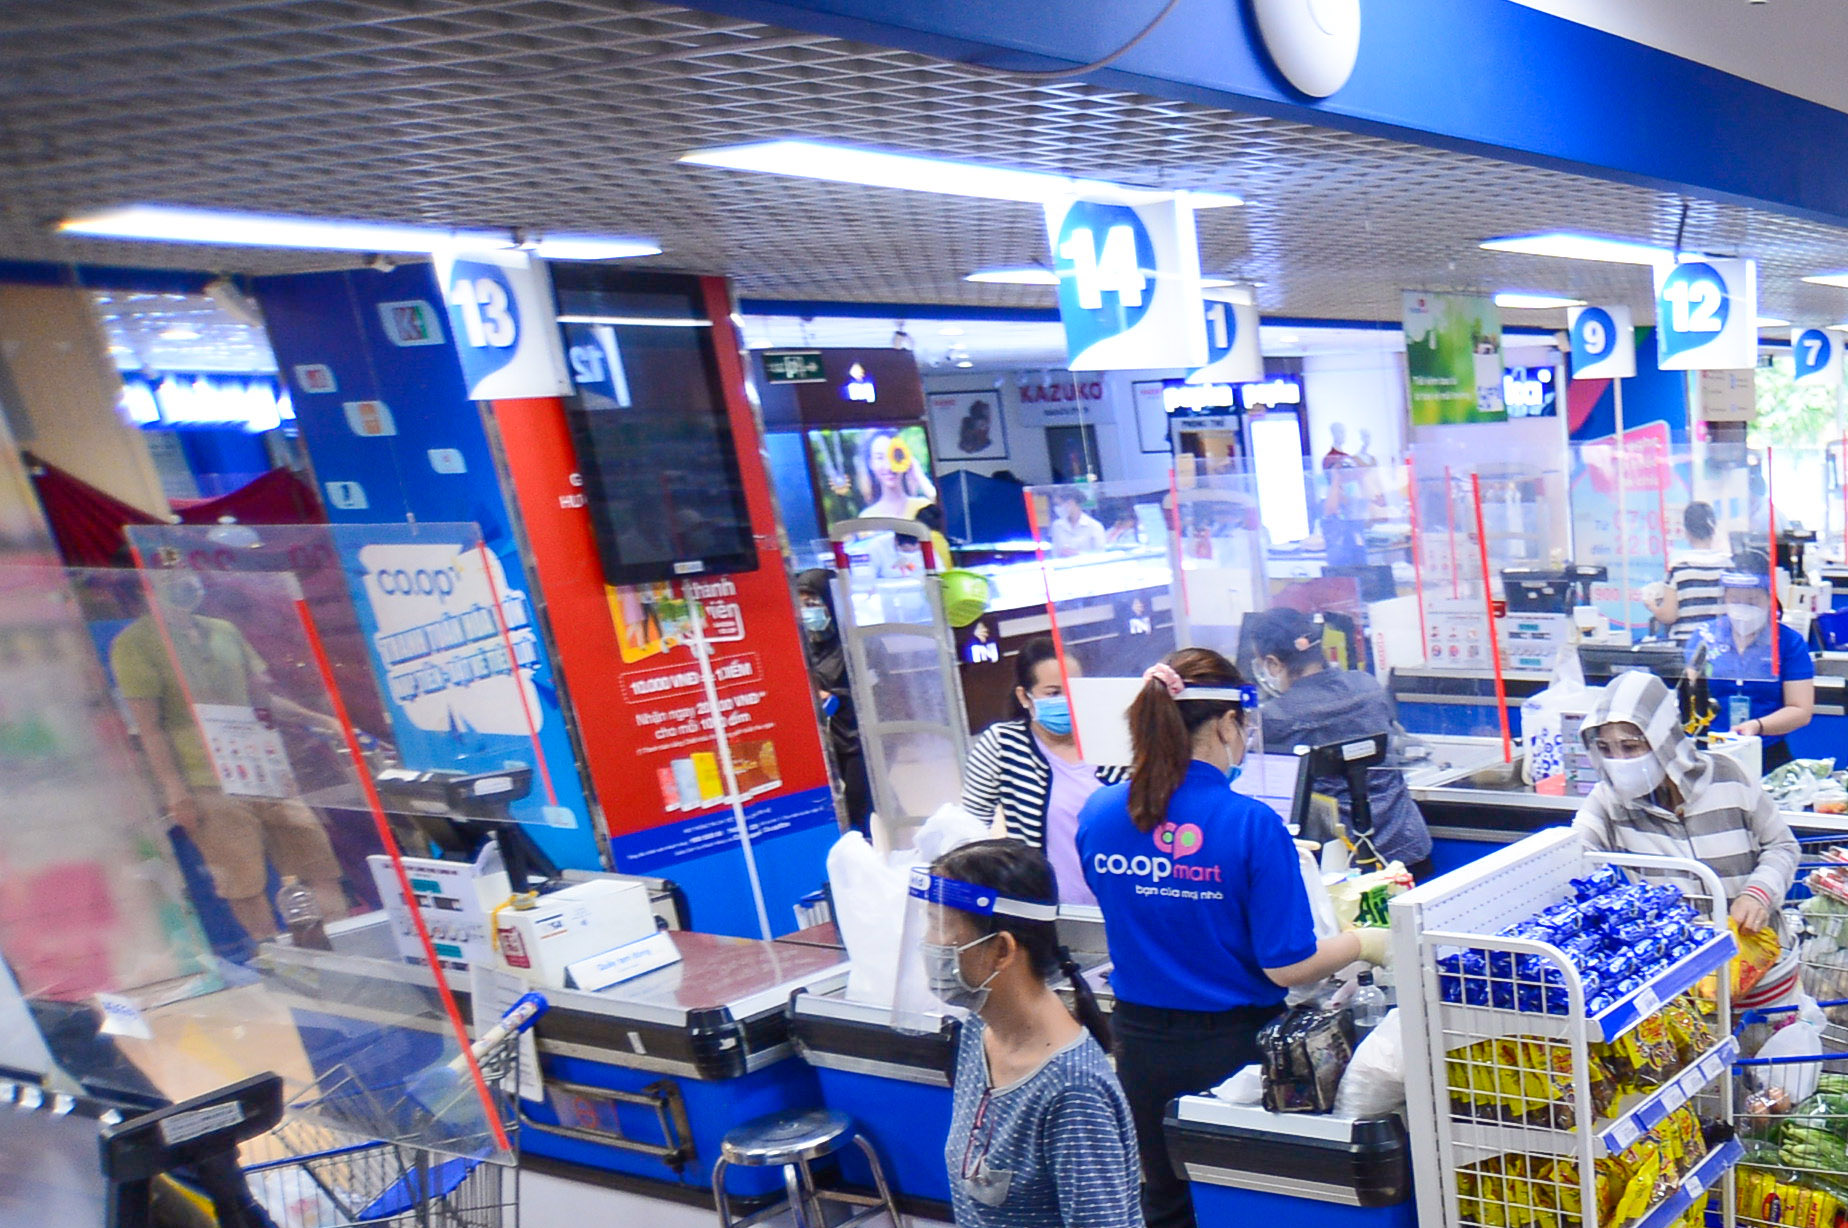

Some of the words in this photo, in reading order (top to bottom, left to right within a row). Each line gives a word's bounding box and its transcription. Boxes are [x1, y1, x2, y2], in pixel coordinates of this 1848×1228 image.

[1060, 224, 1146, 310] 14
[450, 279, 519, 350] 13
[1663, 277, 1723, 333] 12
[1582, 320, 1606, 355] 9
[1802, 338, 1823, 364] 7
[1020, 381, 1103, 404] KAZUKO
[629, 676, 673, 696] 10.000
[1135, 884, 1159, 898] bạn
